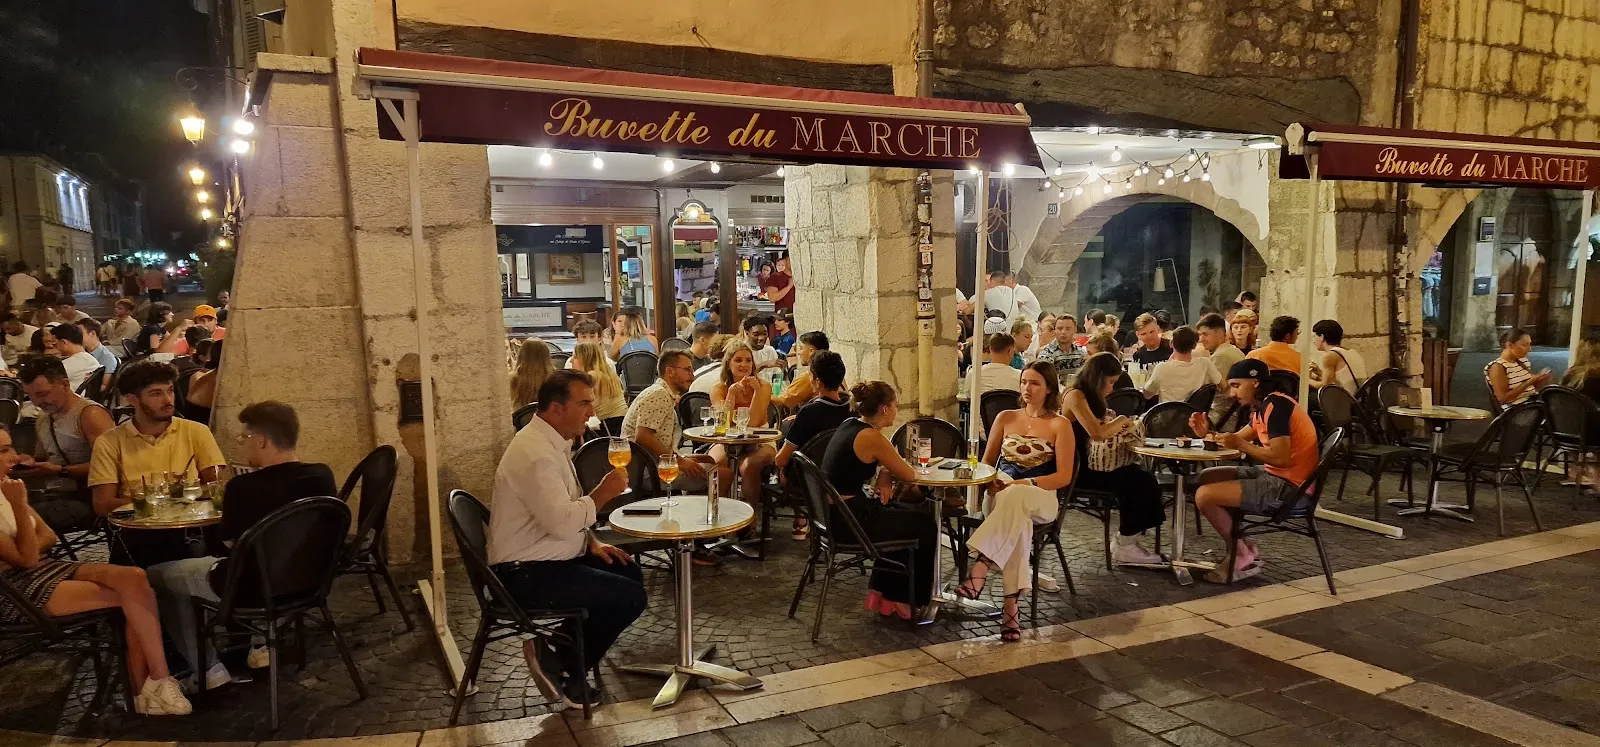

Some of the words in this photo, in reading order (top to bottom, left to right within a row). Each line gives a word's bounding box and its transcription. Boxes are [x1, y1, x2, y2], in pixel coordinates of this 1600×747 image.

[544, 97, 711, 146] Buvette
[728, 112, 777, 148] du
[791, 115, 981, 159] MARCHE
[1375, 147, 1453, 176] Buvette
[1461, 152, 1486, 178] du
[1492, 154, 1589, 183] MARCHE
[1049, 204, 1057, 214] 20
